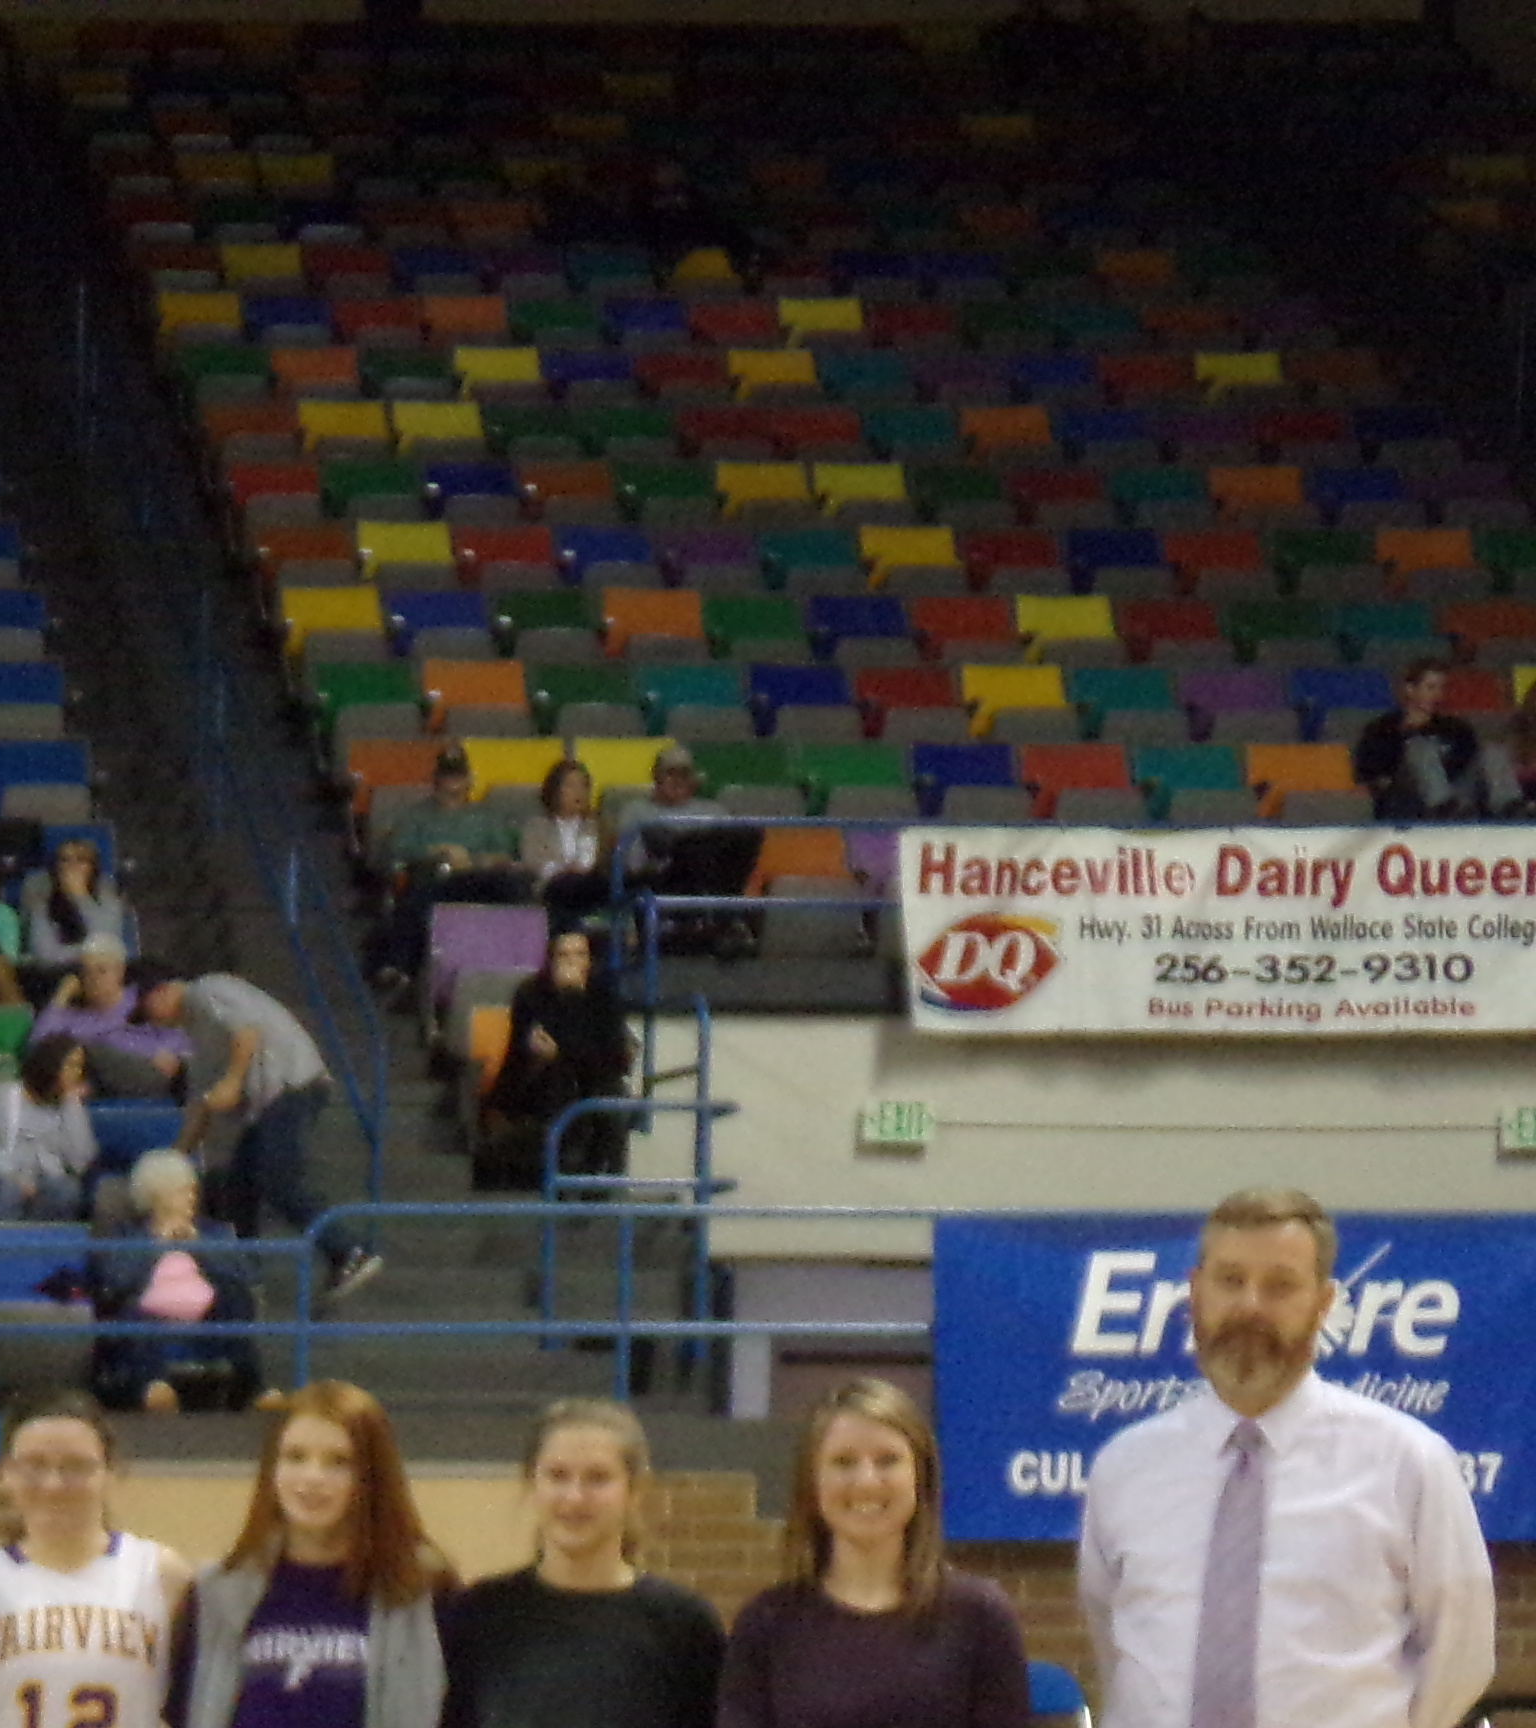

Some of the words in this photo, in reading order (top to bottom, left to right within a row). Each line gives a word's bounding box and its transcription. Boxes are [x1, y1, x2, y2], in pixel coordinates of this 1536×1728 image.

[919, 842, 1196, 896] Hanceville
[1215, 843, 1357, 909] Dairy
[1244, 916, 1301, 941] From
[1311, 914, 1394, 941] Wallace
[1404, 913, 1459, 939] State
[934, 930, 1037, 992] DQ
[1154, 953, 1475, 984] 256-352-9310
[1148, 998, 1194, 1016] Bus
[1206, 998, 1323, 1022] Parking
[1335, 997, 1478, 1018] Available
